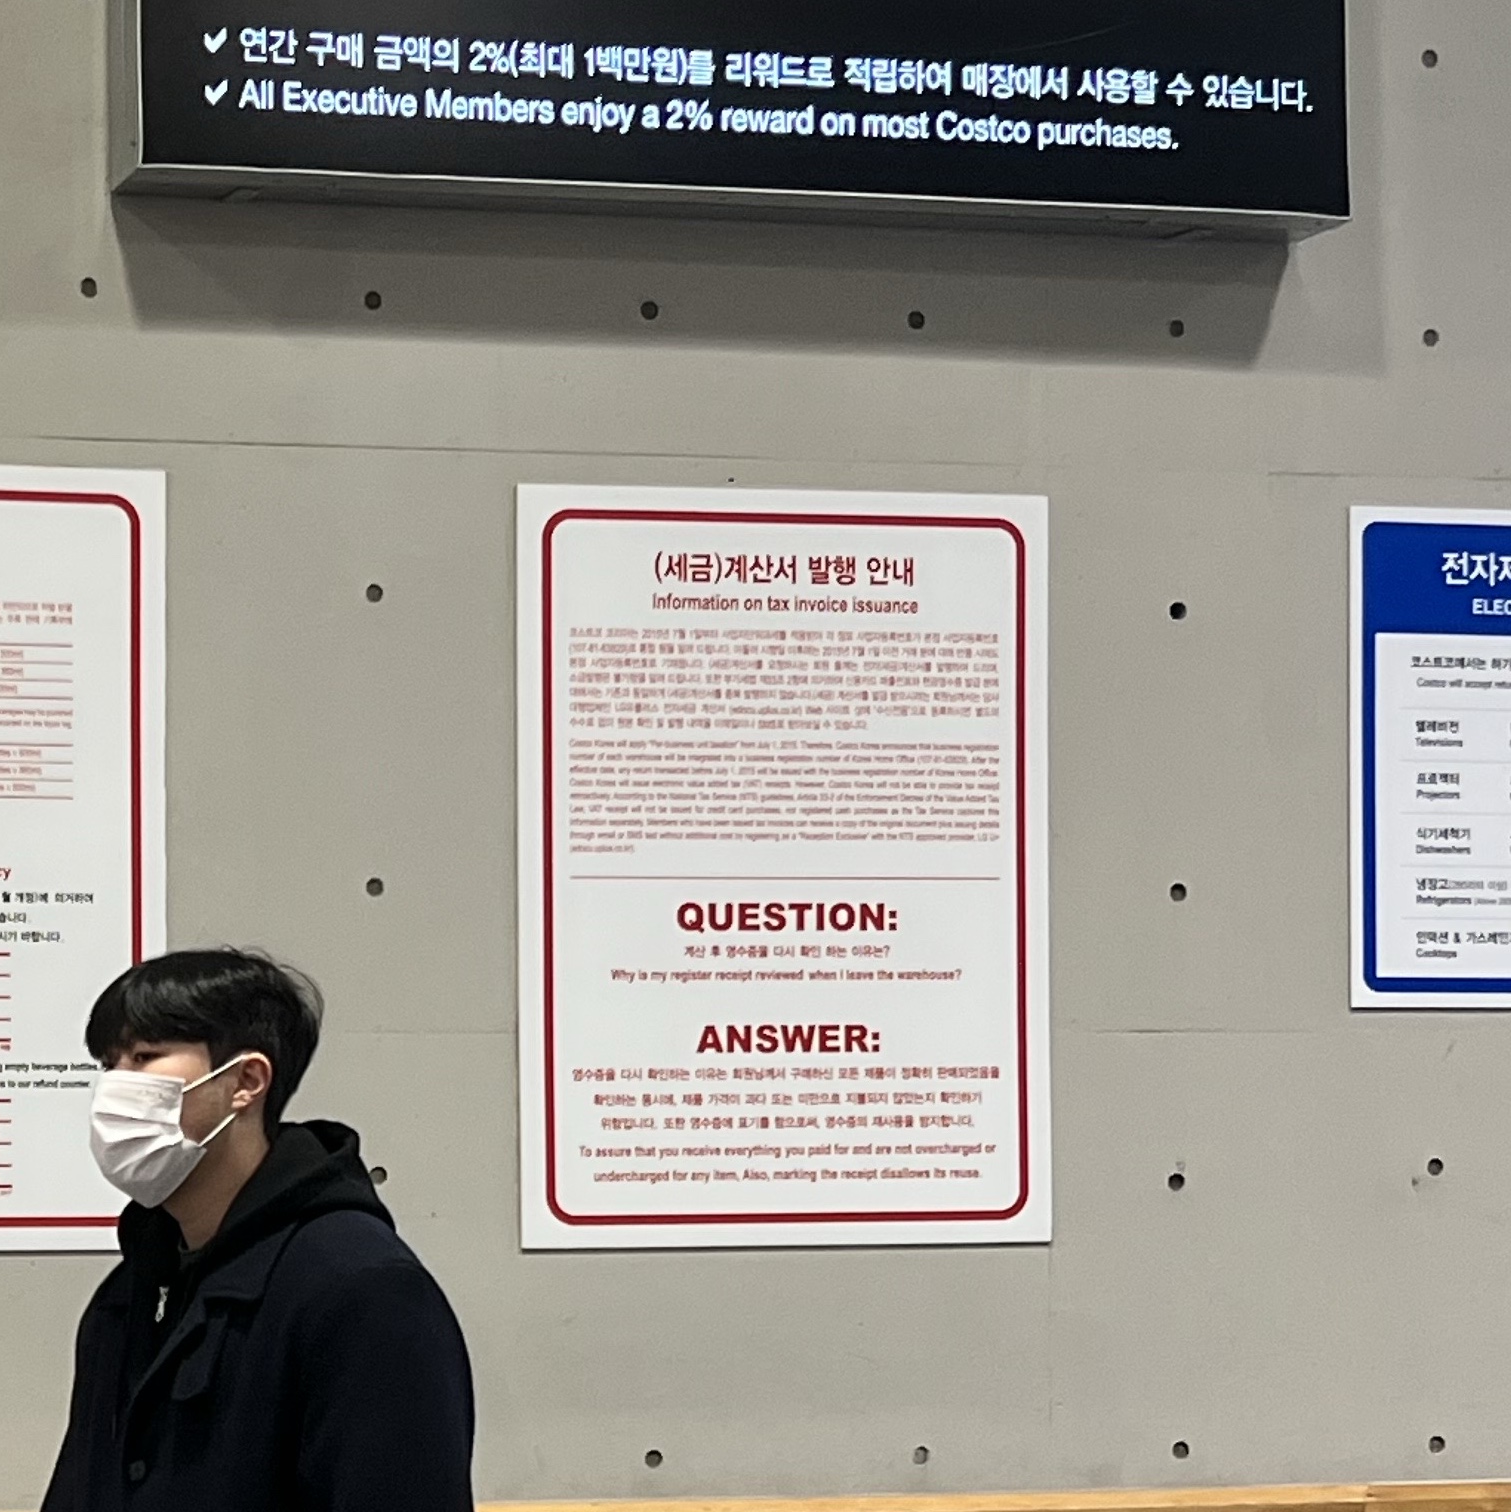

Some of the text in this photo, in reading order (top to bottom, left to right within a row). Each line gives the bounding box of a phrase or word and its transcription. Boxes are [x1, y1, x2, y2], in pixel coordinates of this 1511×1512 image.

[240, 26, 1313, 112] 연간 구매 금액의 2%(최대 1백만원)를 리워드로 적립하여 매장에서 사용할 수 있습니다.
[239, 79, 1179, 150] All Executive Members enjoy a 2% reward on most Costco purchases.
[655, 551, 913, 587] (세금)계산서 발행 안내
[653, 593, 918, 614] Information on tax invoice issuance
[677, 902, 897, 933] QUESTION:
[774, 946, 795, 957] 다시
[611, 969, 635, 983] Why
[638, 970, 648, 980] is
[651, 972, 667, 983] my
[670, 970, 712, 983] register
[715, 970, 752, 982] receipt
[755, 969, 804, 980] reviewed
[808, 970, 837, 980] when
[846, 970, 874, 980] leave
[877, 970, 894, 980] the
[897, 969, 962, 980] warehouse?
[696, 1025, 880, 1053] ANSWER:
[621, 1068, 642, 1080] 다시
[579, 1143, 996, 1159] To assure that you receive everything you paid for and are not overcharged or
[594, 1170, 669, 1184] undercharged
[673, 1170, 688, 1181] for
[691, 1172, 710, 1183] any
[773, 1169, 817, 1182] marking
[821, 1169, 838, 1179] the
[841, 1169, 877, 1181] receipt
[880, 1168, 930, 1179] disallows
[934, 1168, 946, 1178] its
